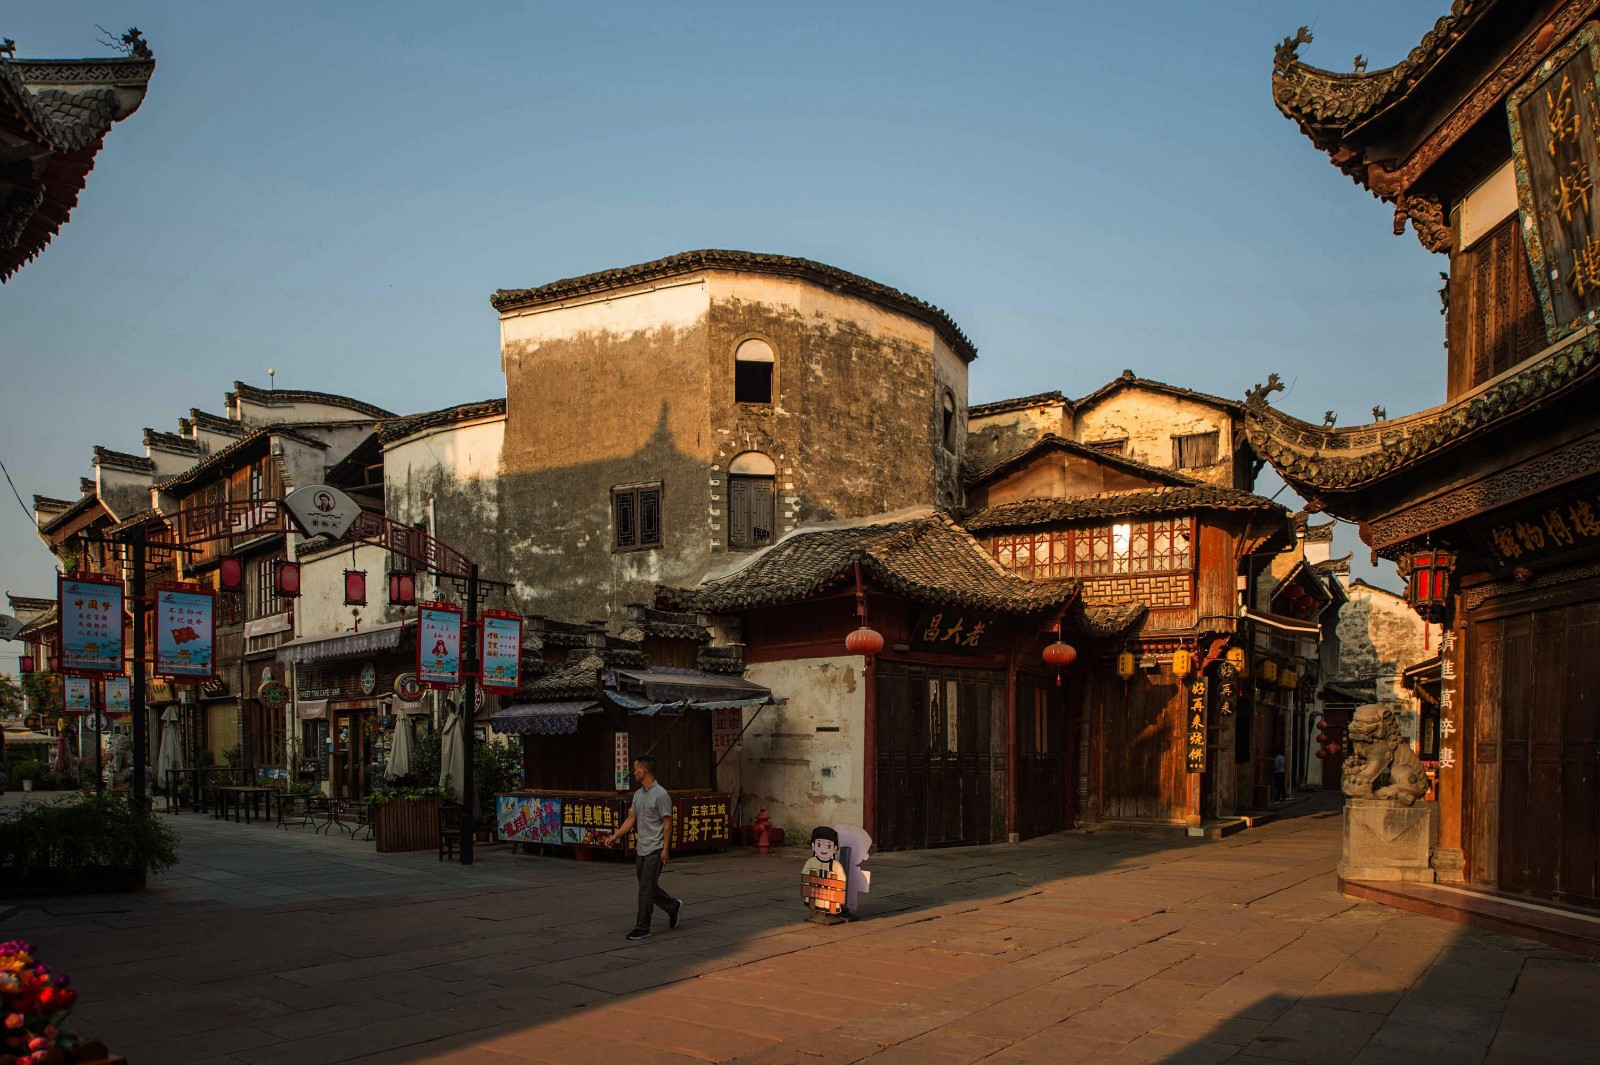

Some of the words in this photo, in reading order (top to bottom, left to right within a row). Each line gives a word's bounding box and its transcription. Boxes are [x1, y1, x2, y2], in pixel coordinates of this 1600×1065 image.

[716, 718, 739, 729] 正宗
[687, 818, 723, 842] 茶干王
